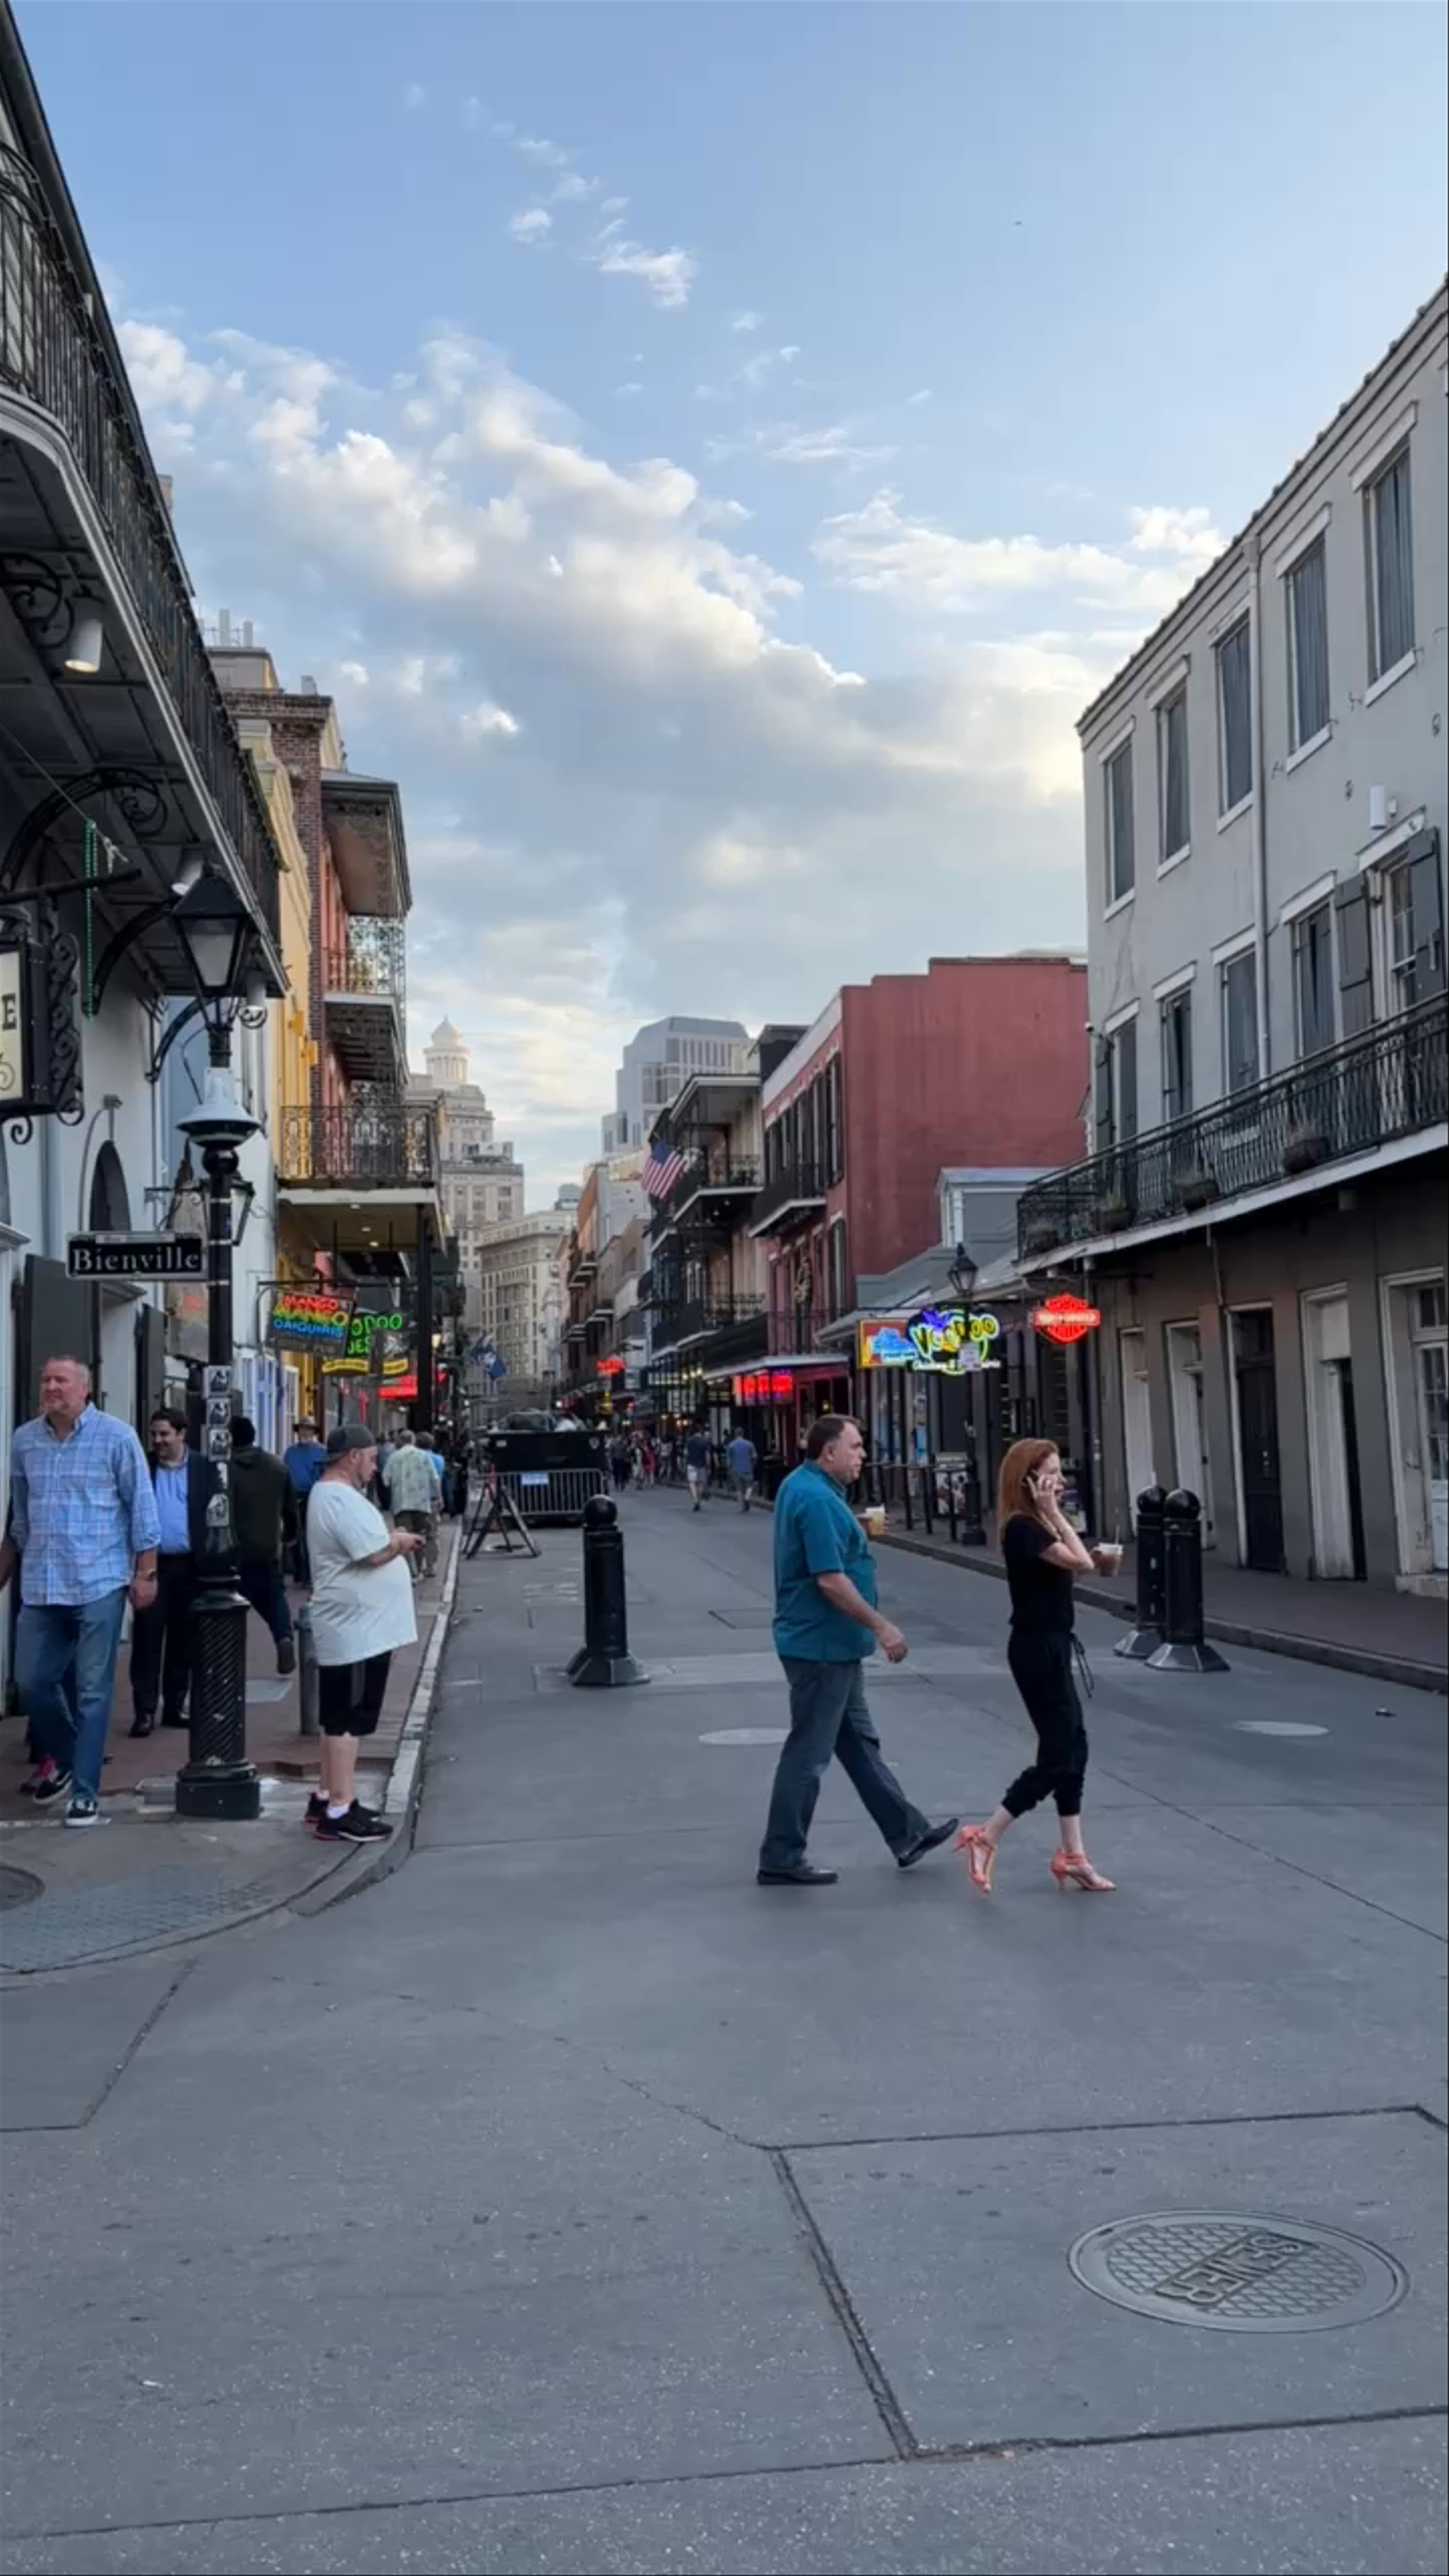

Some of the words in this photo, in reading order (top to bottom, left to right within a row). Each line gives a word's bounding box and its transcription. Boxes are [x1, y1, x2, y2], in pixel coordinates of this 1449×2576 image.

[73, 1246, 199, 1271] Bienville
[284, 1294, 338, 1310] MANGO
[1156, 2236, 1302, 2302] SEWER
